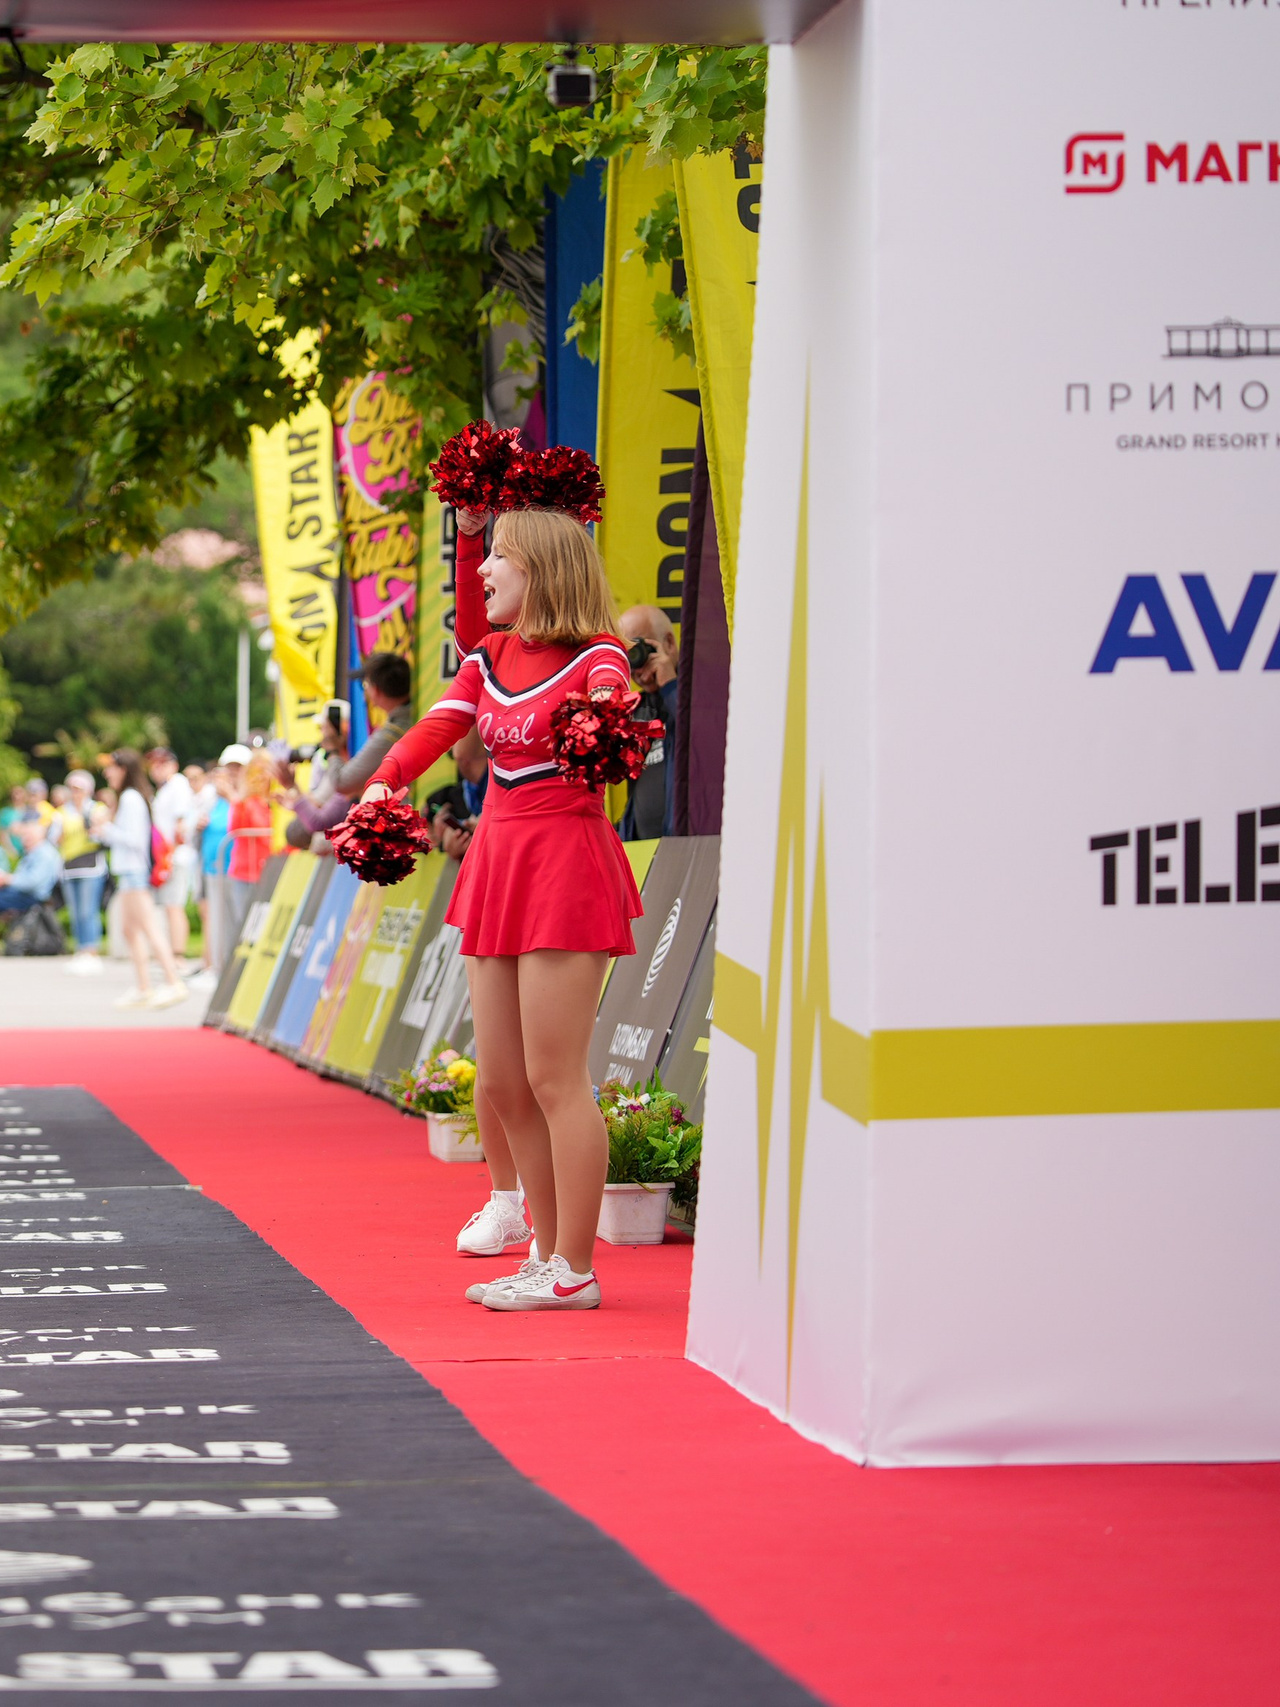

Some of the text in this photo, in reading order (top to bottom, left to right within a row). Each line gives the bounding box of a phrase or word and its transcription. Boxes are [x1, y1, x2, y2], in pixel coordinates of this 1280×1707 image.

[1066, 380, 1269, 413] ПРИМО
[1116, 432, 1269, 450] GRAND RESORT
[286, 427, 323, 540] STAR
[1089, 803, 1280, 906] TELE
[17, 1648, 497, 1683] STAR
